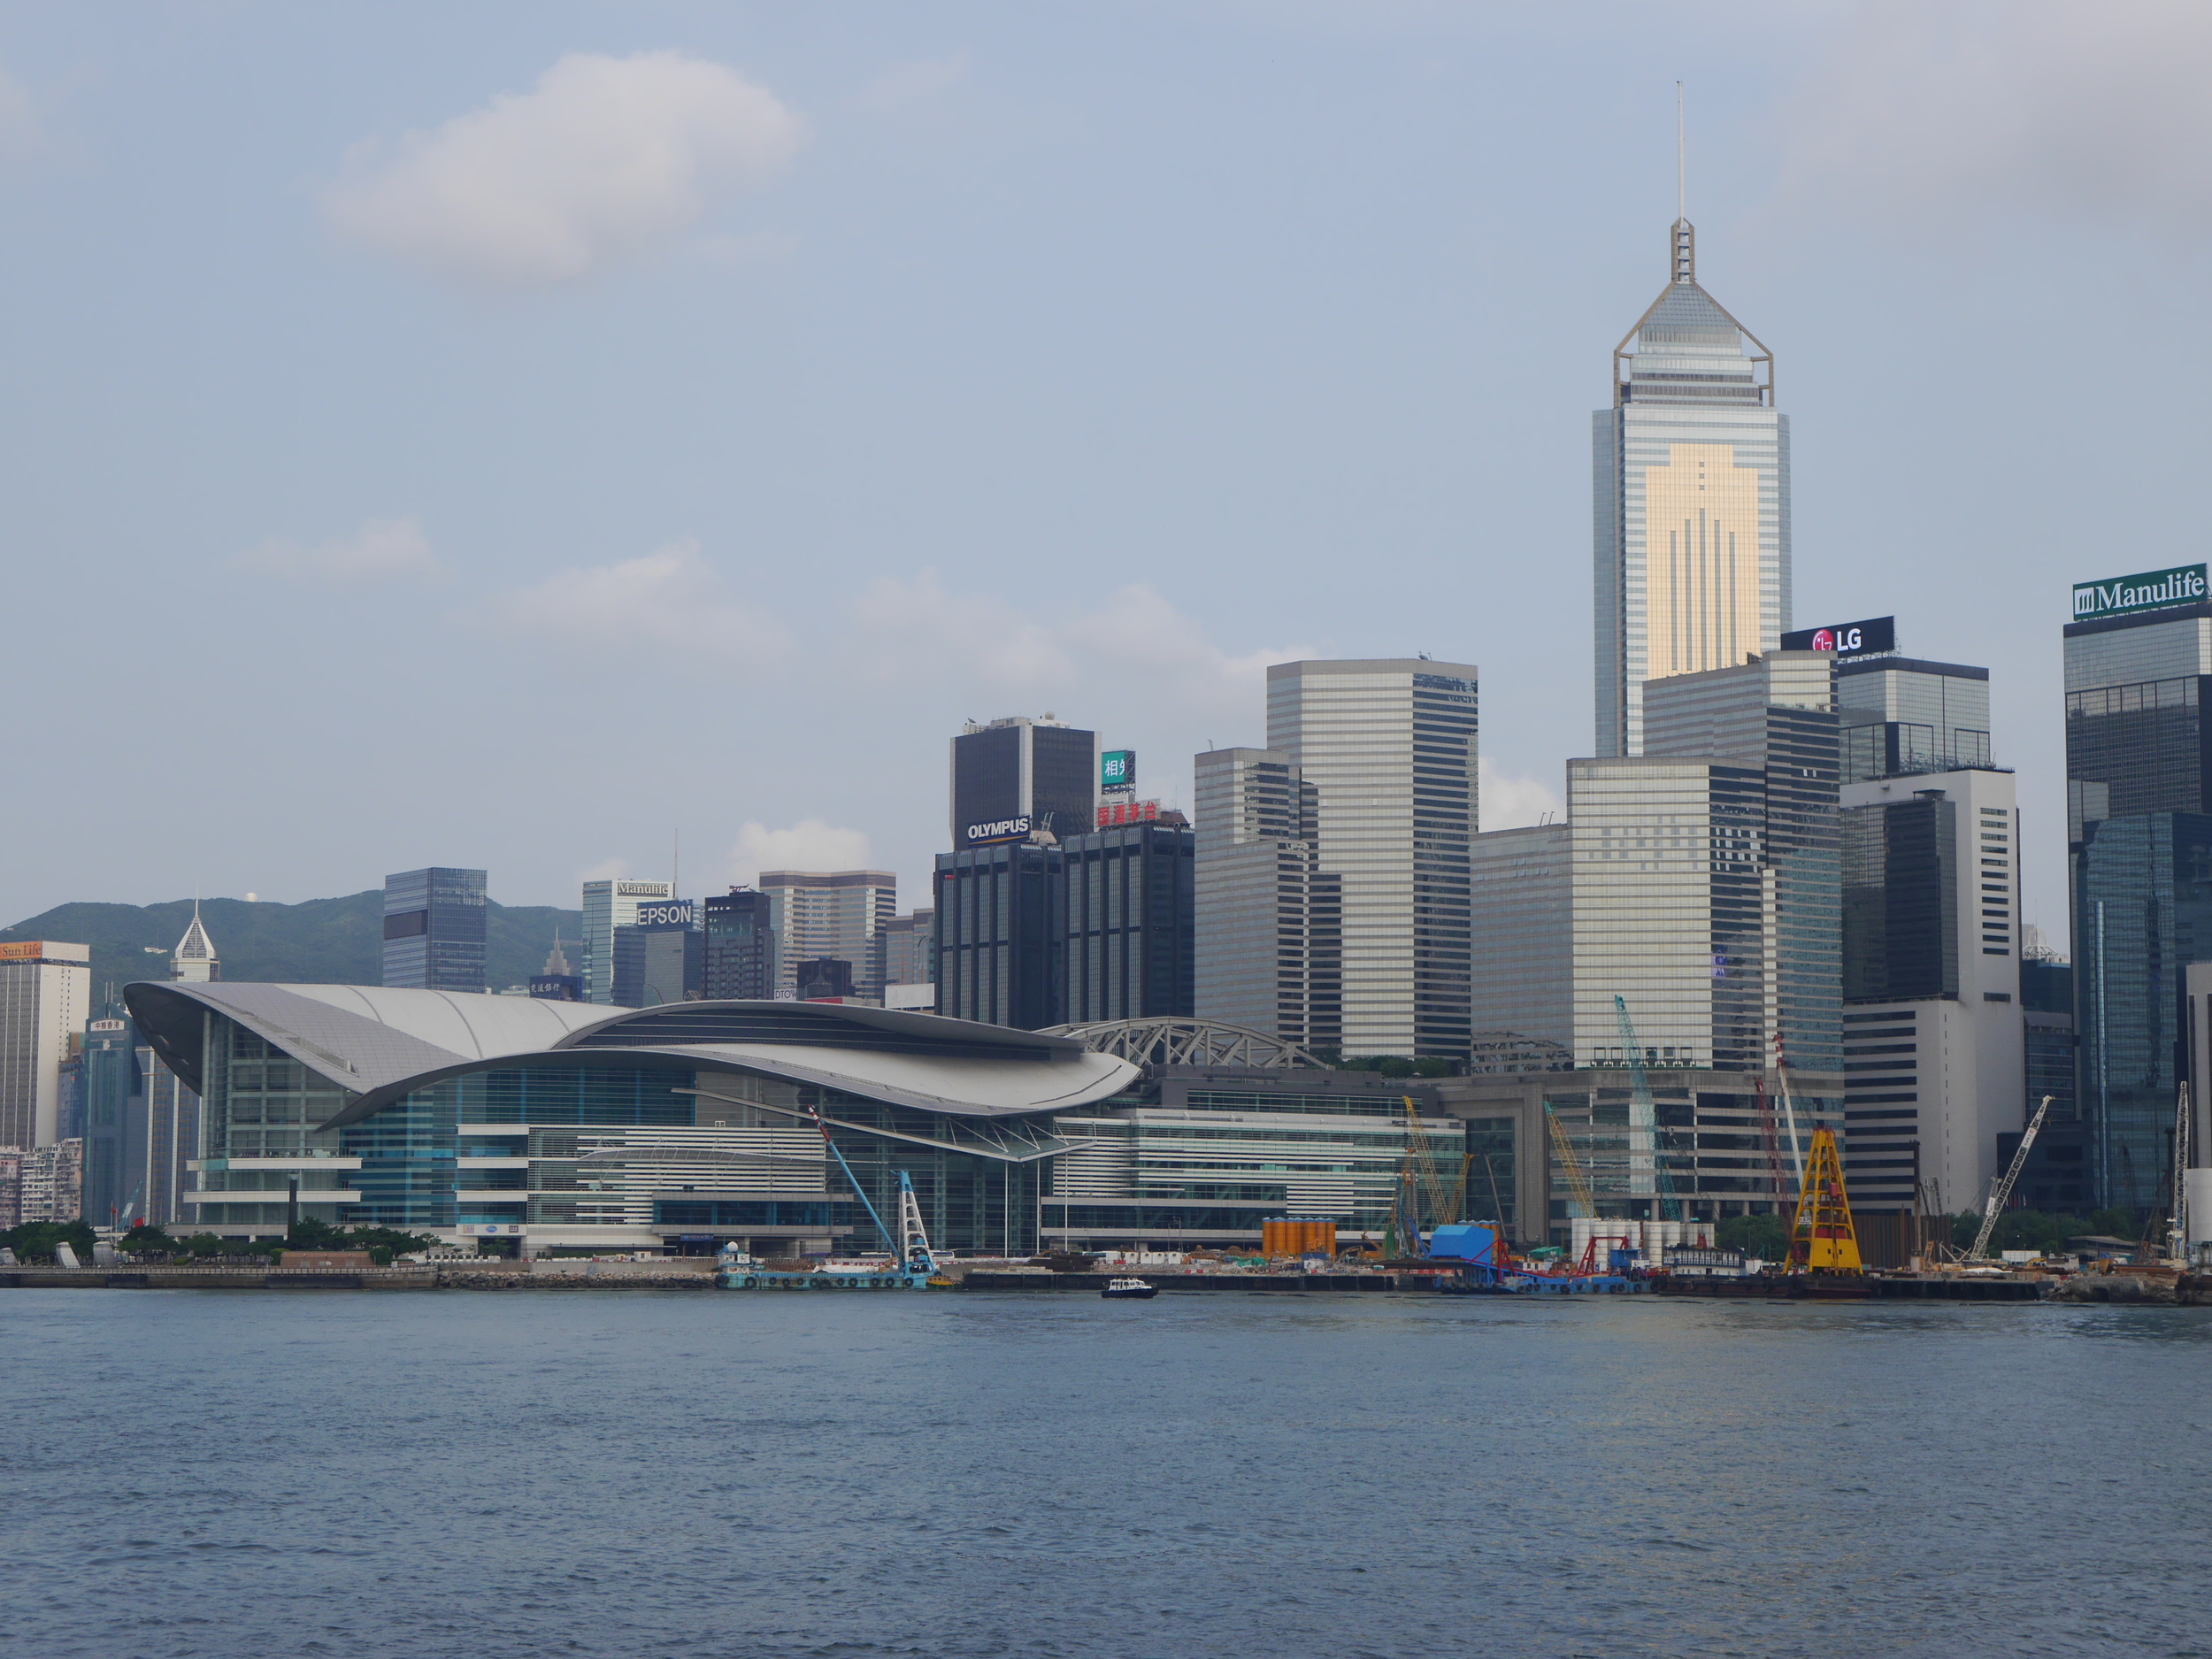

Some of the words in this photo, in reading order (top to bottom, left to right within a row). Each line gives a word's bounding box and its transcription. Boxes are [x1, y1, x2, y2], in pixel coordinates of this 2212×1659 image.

[2095, 570, 2205, 611] Manulife
[1837, 627, 1862, 652] LG
[1098, 801, 1157, 827] 国酒茅台
[968, 818, 1029, 839] OLYMPUS
[618, 883, 669, 895] Manulife
[637, 905, 691, 926] EPSON
[2, 946, 21, 956] Sun
[23, 944, 41, 956] Life
[531, 983, 560, 994] 交通銀行
